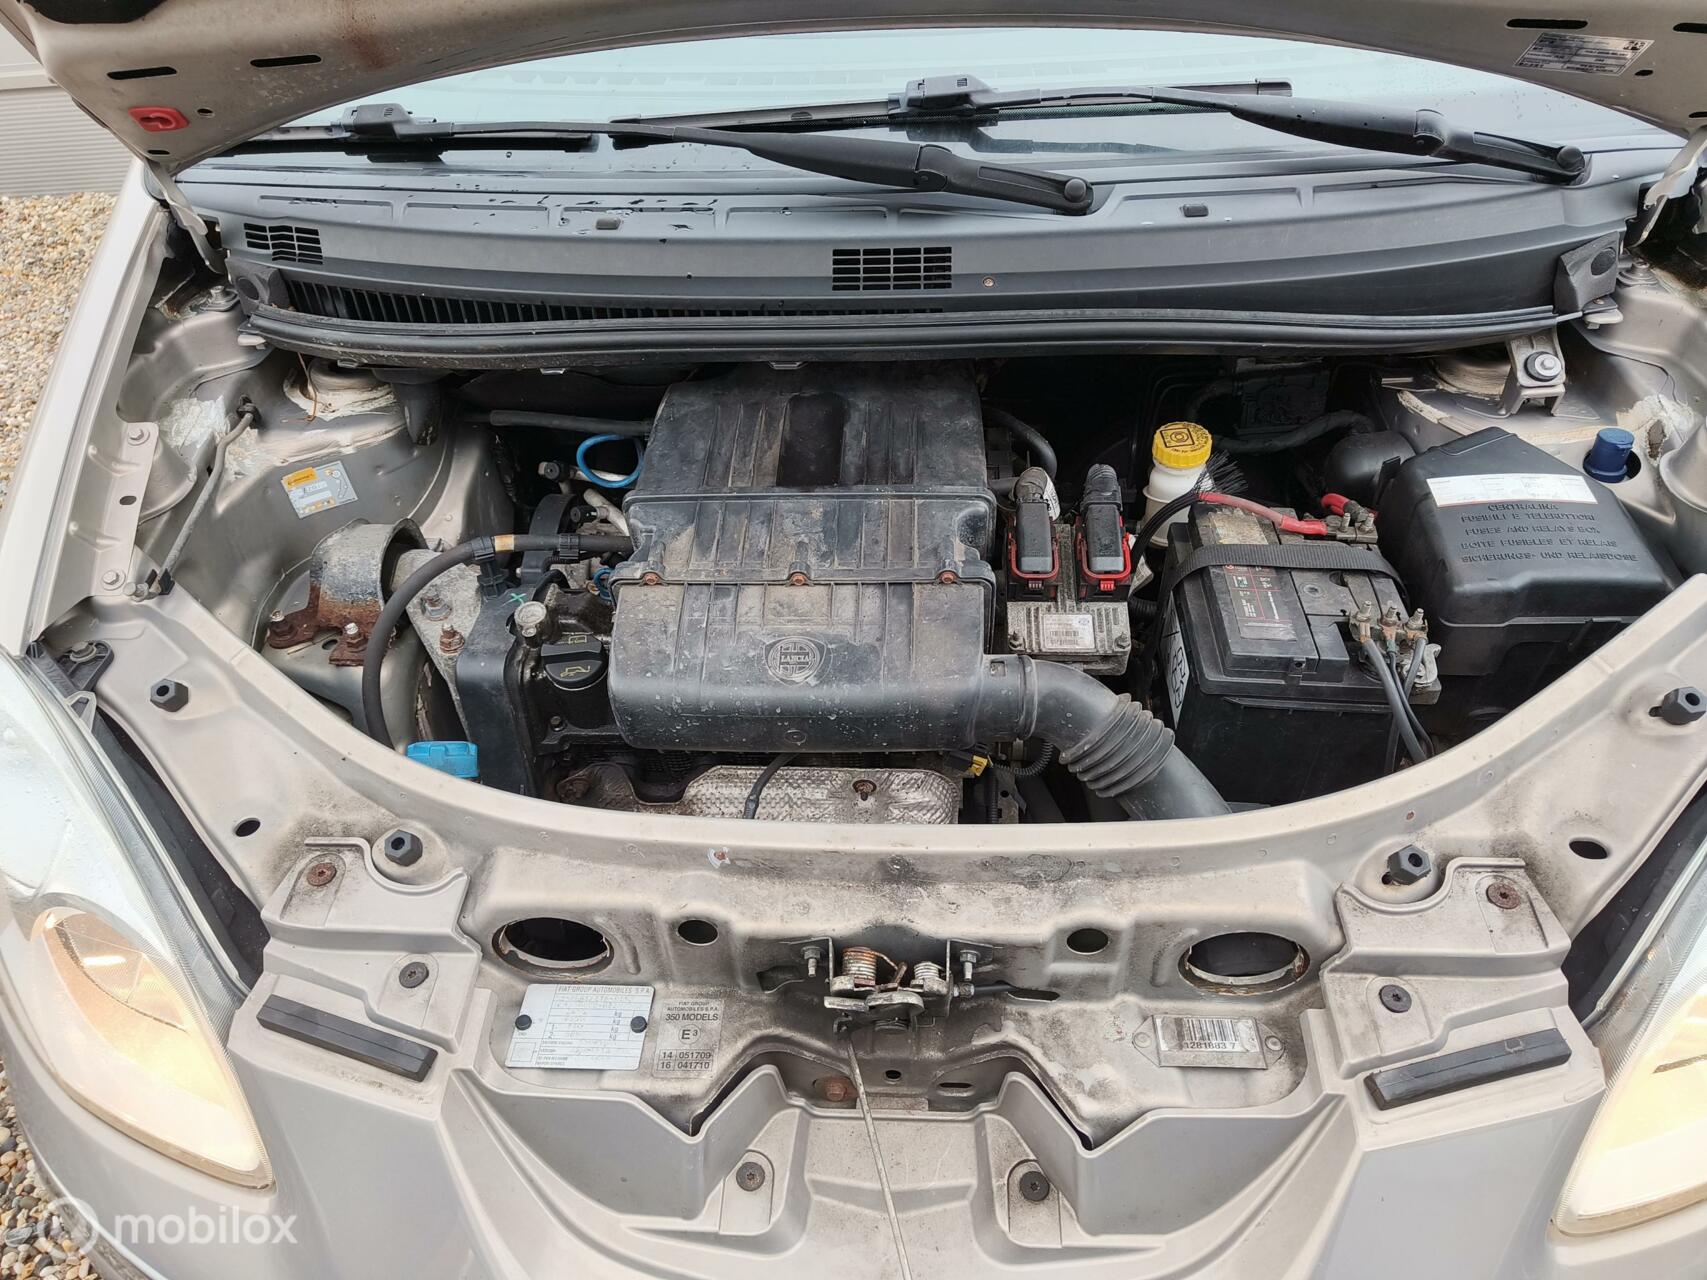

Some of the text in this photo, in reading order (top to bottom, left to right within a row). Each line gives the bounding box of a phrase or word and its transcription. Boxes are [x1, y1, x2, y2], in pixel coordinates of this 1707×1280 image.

[1461, 513, 1507, 523] FUSIBILI
[1464, 525, 1601, 536] FUSES AND RELAYS BOX
[1558, 538, 1574, 546] ET
[1577, 539, 1618, 548] RELAIS
[1540, 551, 1564, 559] UND
[558, 985, 572, 993] FIAT
[572, 985, 593, 993] GROUP
[592, 986, 632, 994] AUTOMOBILES
[665, 1013, 719, 1021] 350 MODELS
[662, 1051, 711, 1059] 14 051709
[660, 1061, 710, 1069] 16 041710
